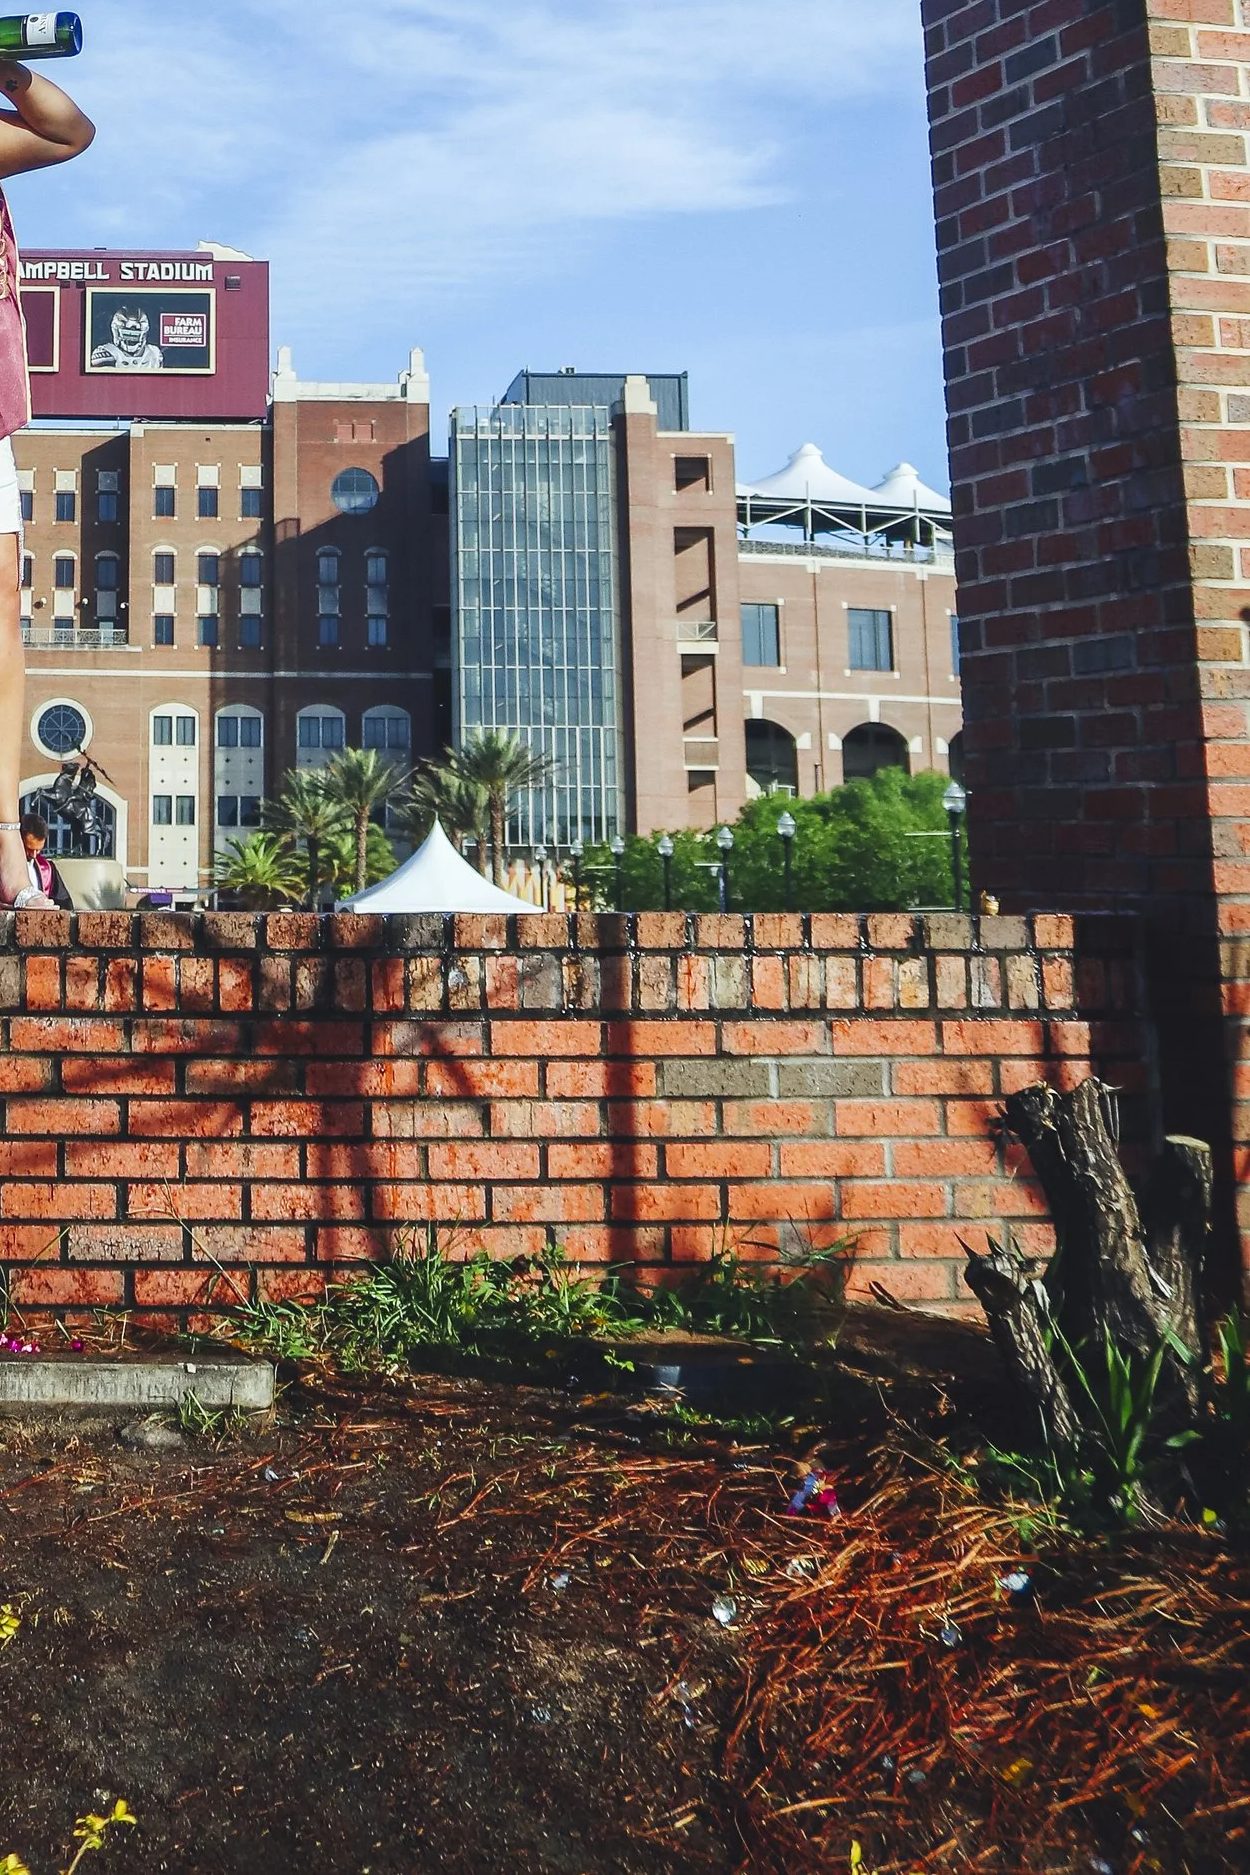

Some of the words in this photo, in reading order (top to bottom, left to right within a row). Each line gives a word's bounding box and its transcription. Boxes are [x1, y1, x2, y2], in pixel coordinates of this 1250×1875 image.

[120, 262, 214, 281] STADIUM
[174, 316, 202, 326] FARM
[163, 326, 203, 335] BUREAU
